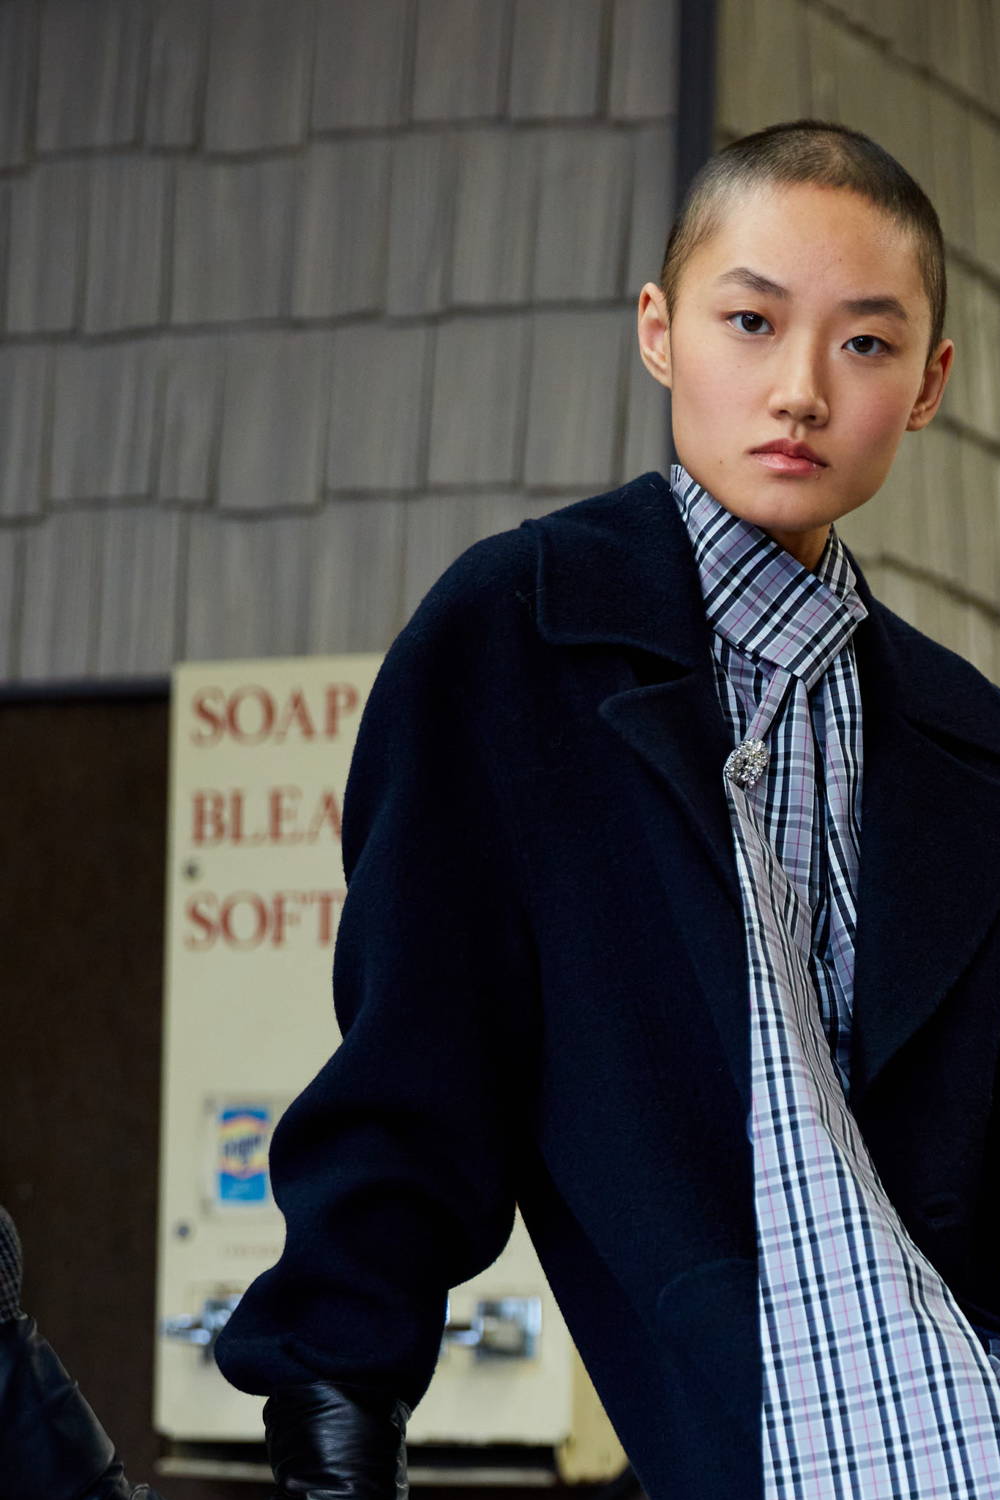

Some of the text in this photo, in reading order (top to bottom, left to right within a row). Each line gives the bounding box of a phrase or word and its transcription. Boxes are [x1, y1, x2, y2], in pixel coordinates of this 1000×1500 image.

[191, 684, 359, 746] SOAP
[191, 786, 342, 848] BLEA
[185, 890, 348, 951] SOFT
